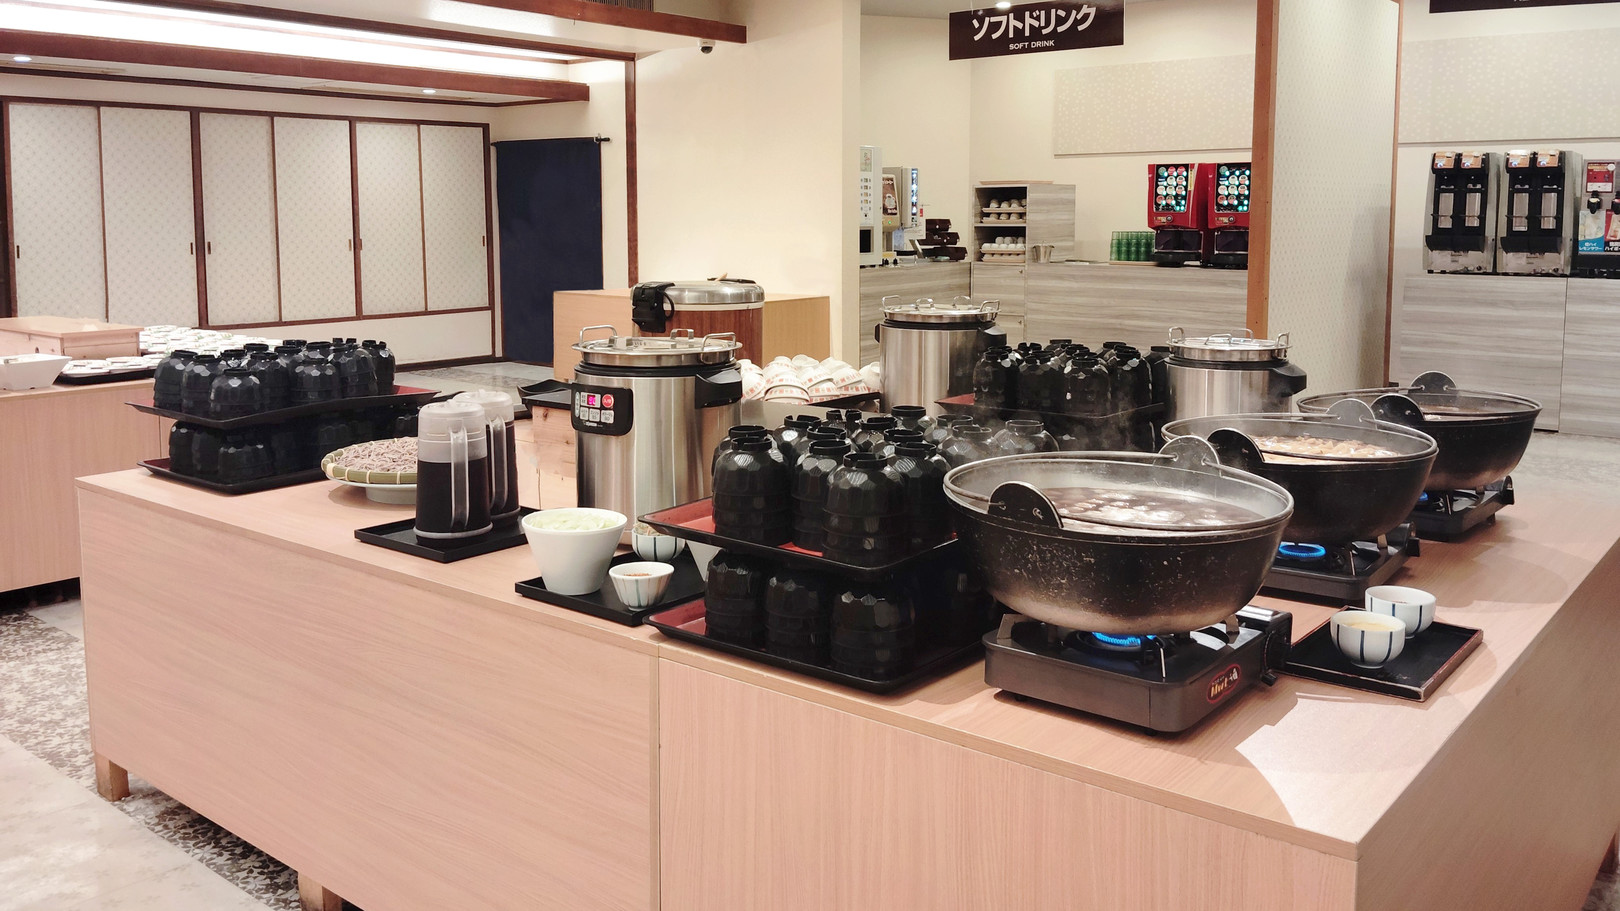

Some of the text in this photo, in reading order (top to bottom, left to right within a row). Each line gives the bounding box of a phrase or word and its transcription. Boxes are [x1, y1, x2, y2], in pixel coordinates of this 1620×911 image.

[972, 5, 1096, 41] ソフトドリンク
[1009, 40, 1055, 50] SOFT DRINK
